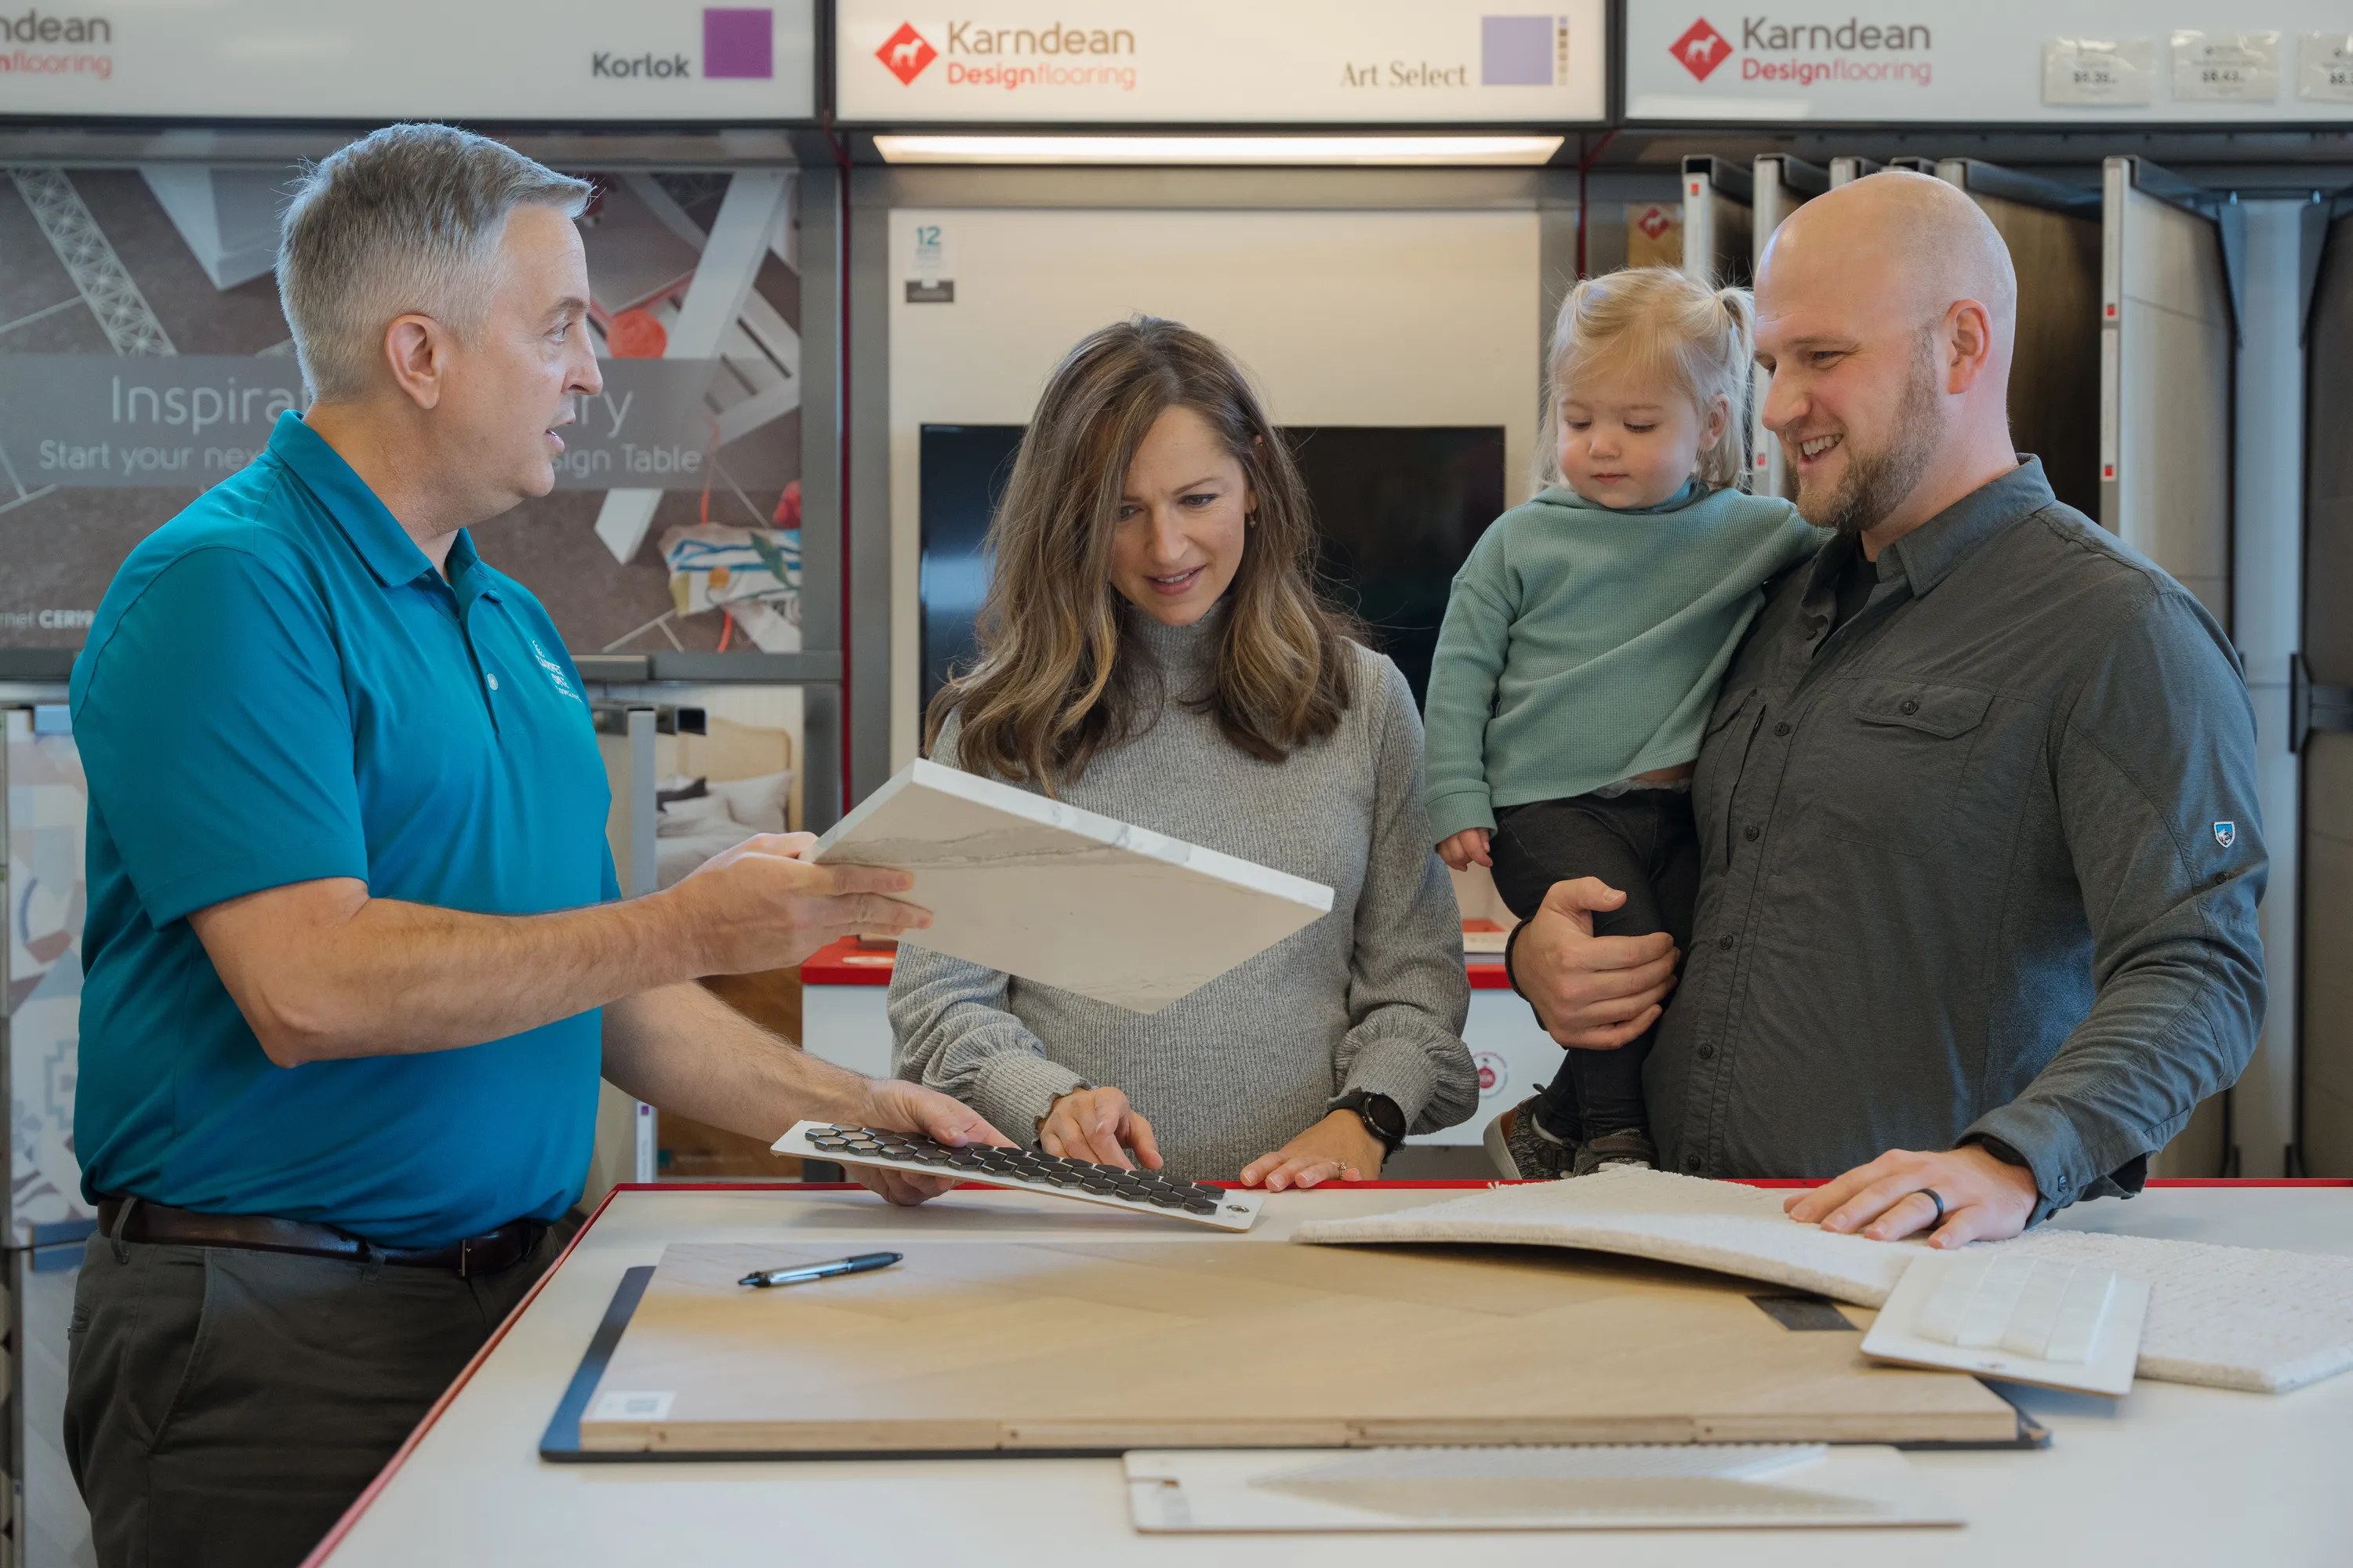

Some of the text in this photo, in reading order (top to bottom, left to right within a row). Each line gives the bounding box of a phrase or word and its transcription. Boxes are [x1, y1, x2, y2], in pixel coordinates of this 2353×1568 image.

[948, 22, 1135, 55] Karndean
[1742, 17, 1931, 50] Karndean
[591, 53, 691, 78] Korlok
[948, 63, 1136, 89] Designflooring
[1340, 61, 1468, 88] Art Select
[1742, 59, 1932, 85] Designflooring
[917, 226, 942, 245] 12
[39, 439, 703, 480] Start your nex sign Table
